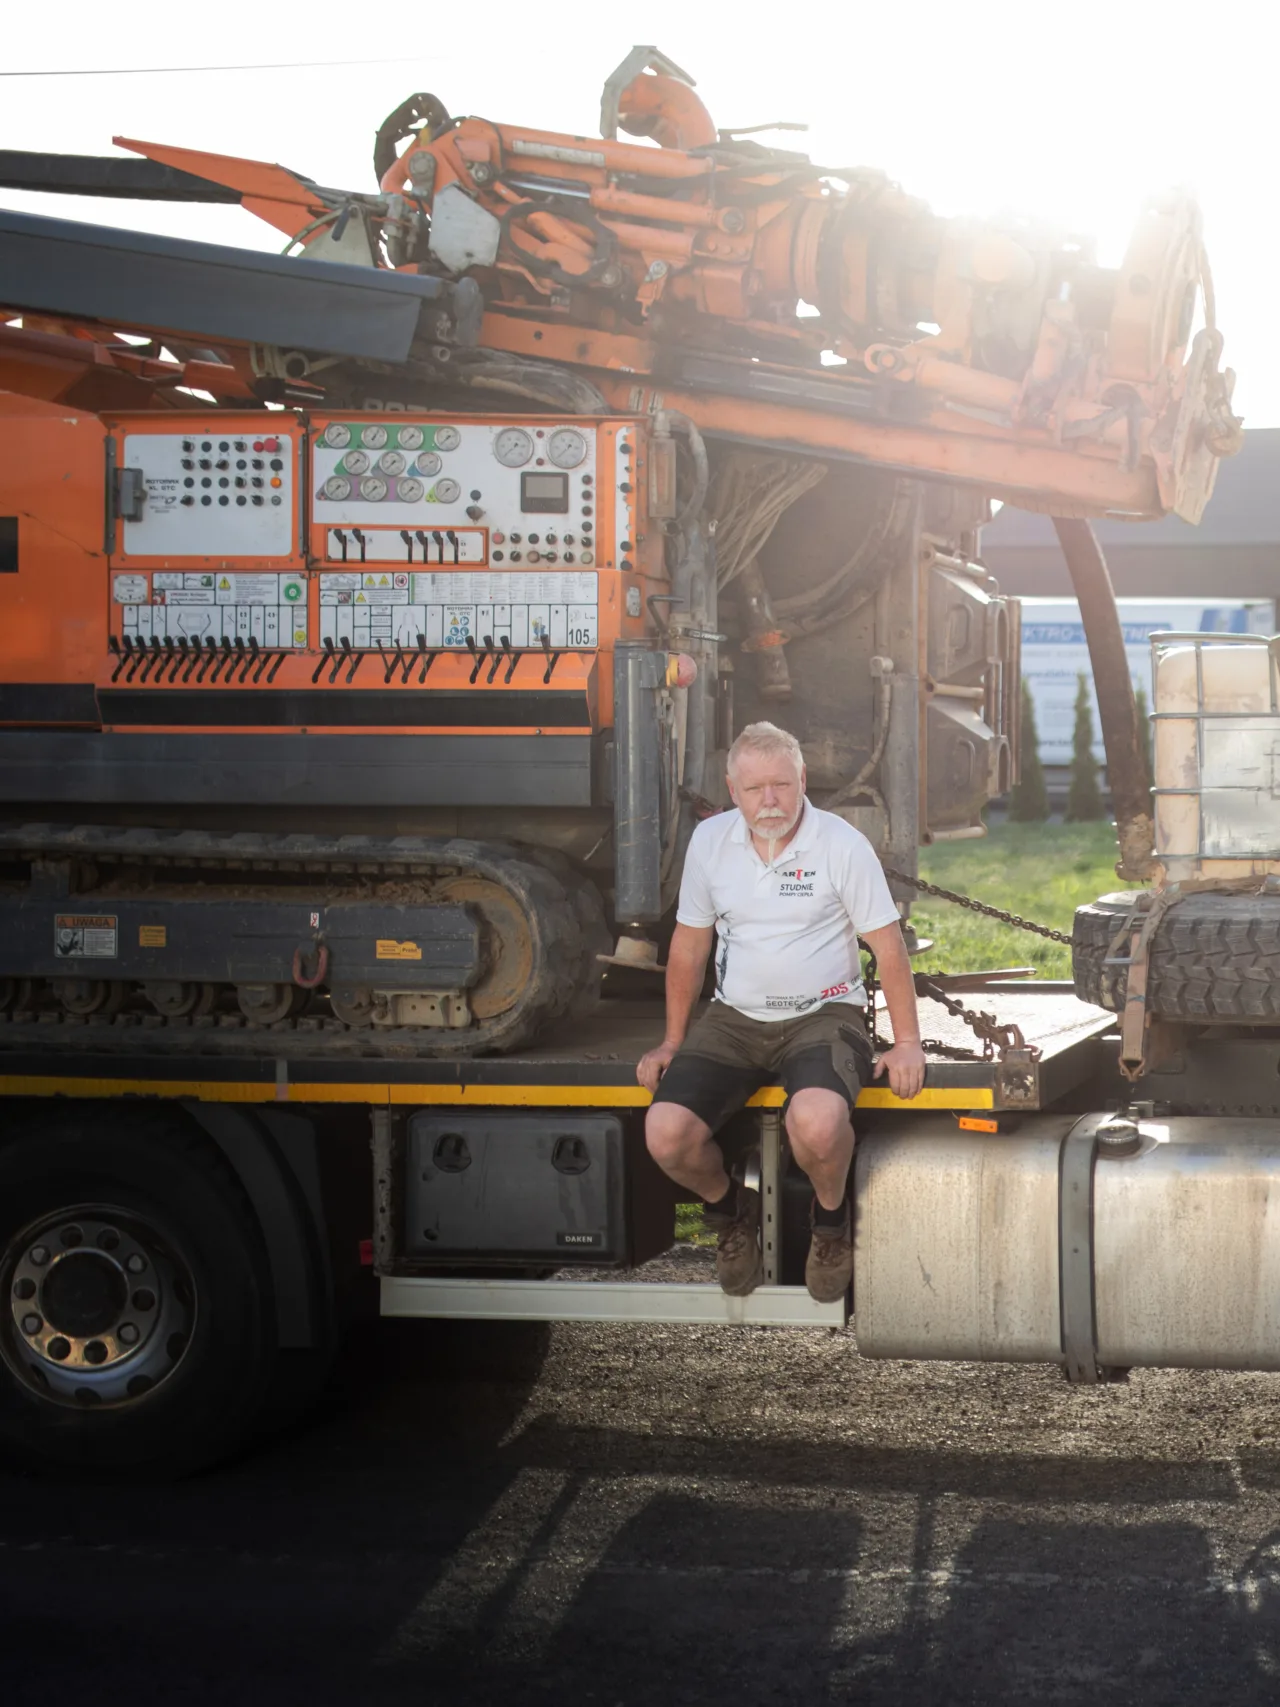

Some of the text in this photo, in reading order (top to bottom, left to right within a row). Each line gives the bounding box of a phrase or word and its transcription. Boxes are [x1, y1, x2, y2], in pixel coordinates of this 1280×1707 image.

[568, 628, 590, 645] 105
[782, 869, 816, 880] ARTEN
[780, 883, 814, 891] STUDNIE
[72, 917, 110, 926] UWAGA
[821, 982, 849, 1000] ZDS
[565, 1235, 593, 1243] DAKEN
